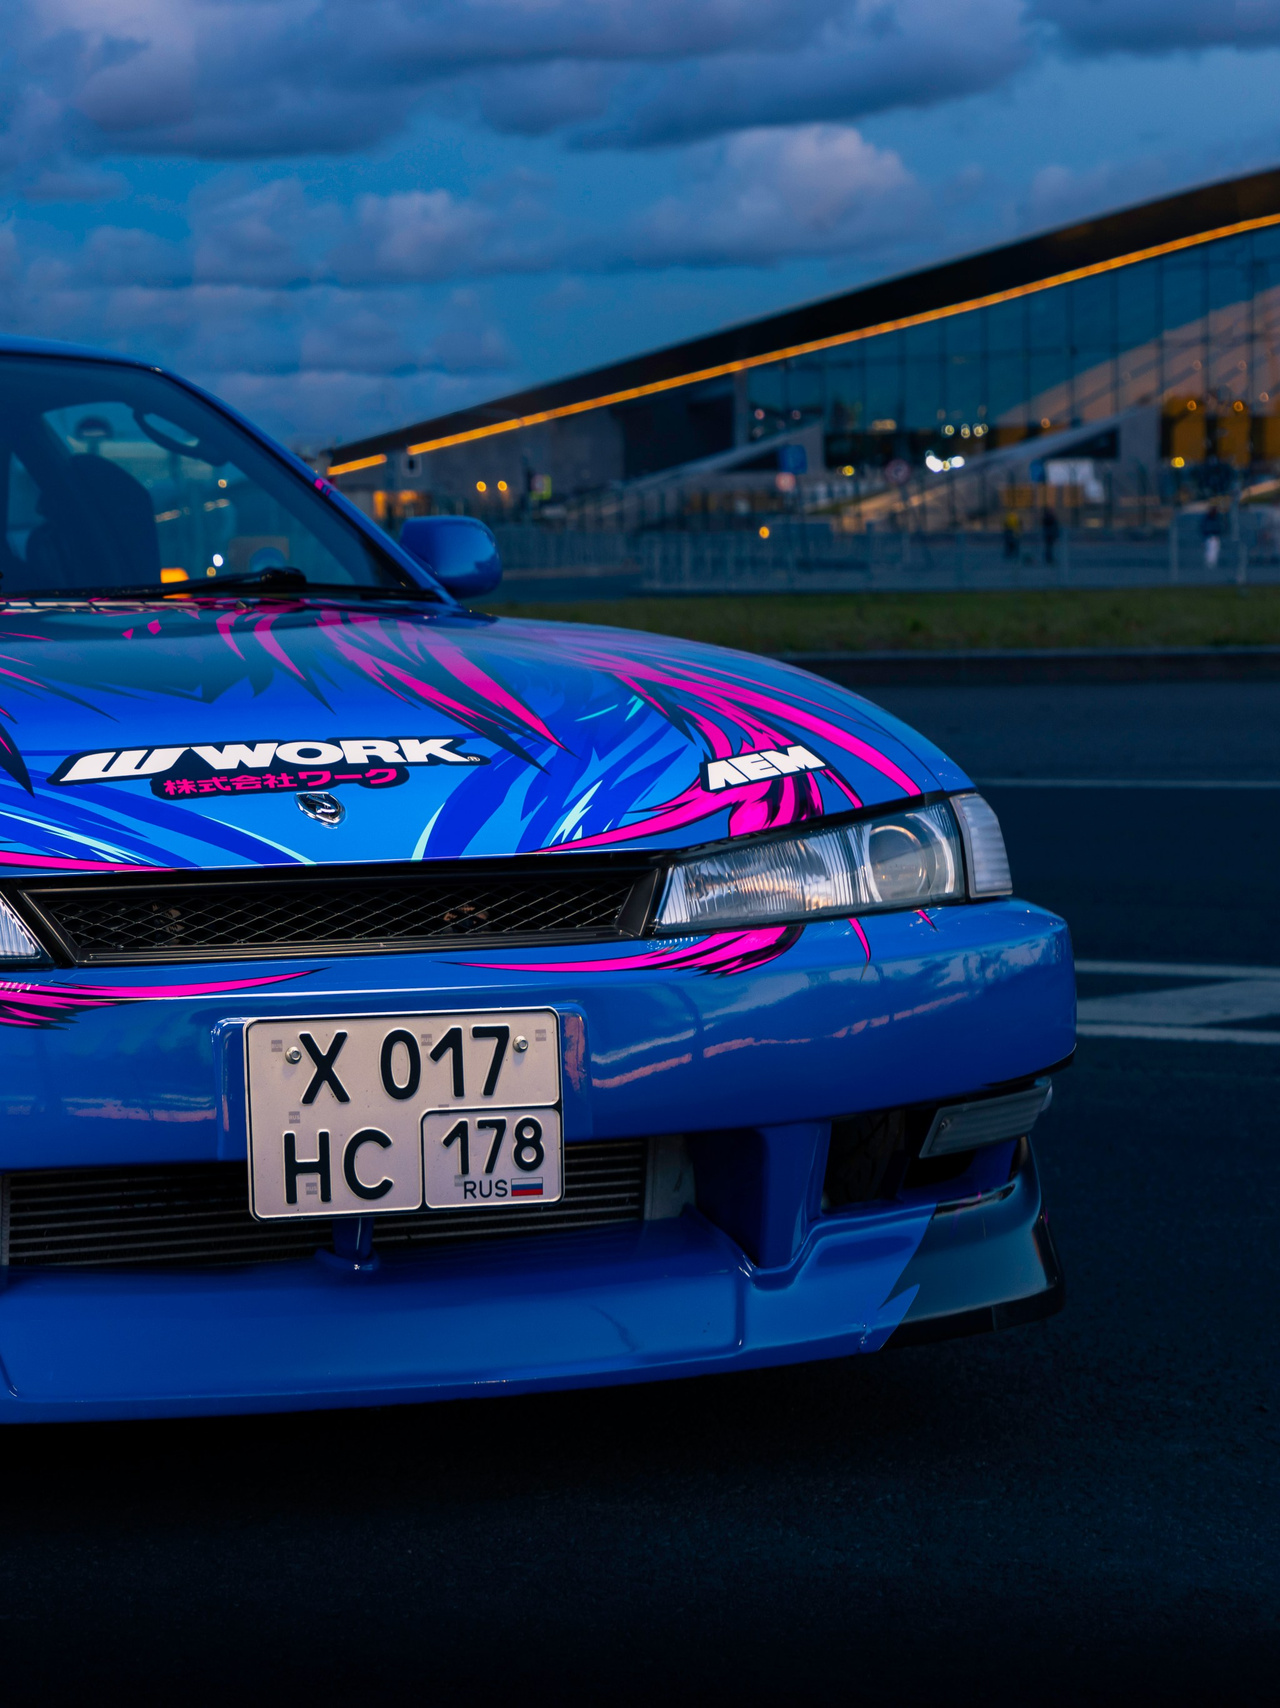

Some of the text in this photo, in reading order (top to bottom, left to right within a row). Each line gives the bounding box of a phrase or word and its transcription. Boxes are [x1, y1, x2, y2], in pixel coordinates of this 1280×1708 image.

[188, 738, 470, 770] WORK
[164, 768, 397, 796] 株式会社ワーク
[380, 1025, 510, 1100] 017
[442, 1116, 545, 1175] 178
[463, 1180, 508, 1200] RUS
